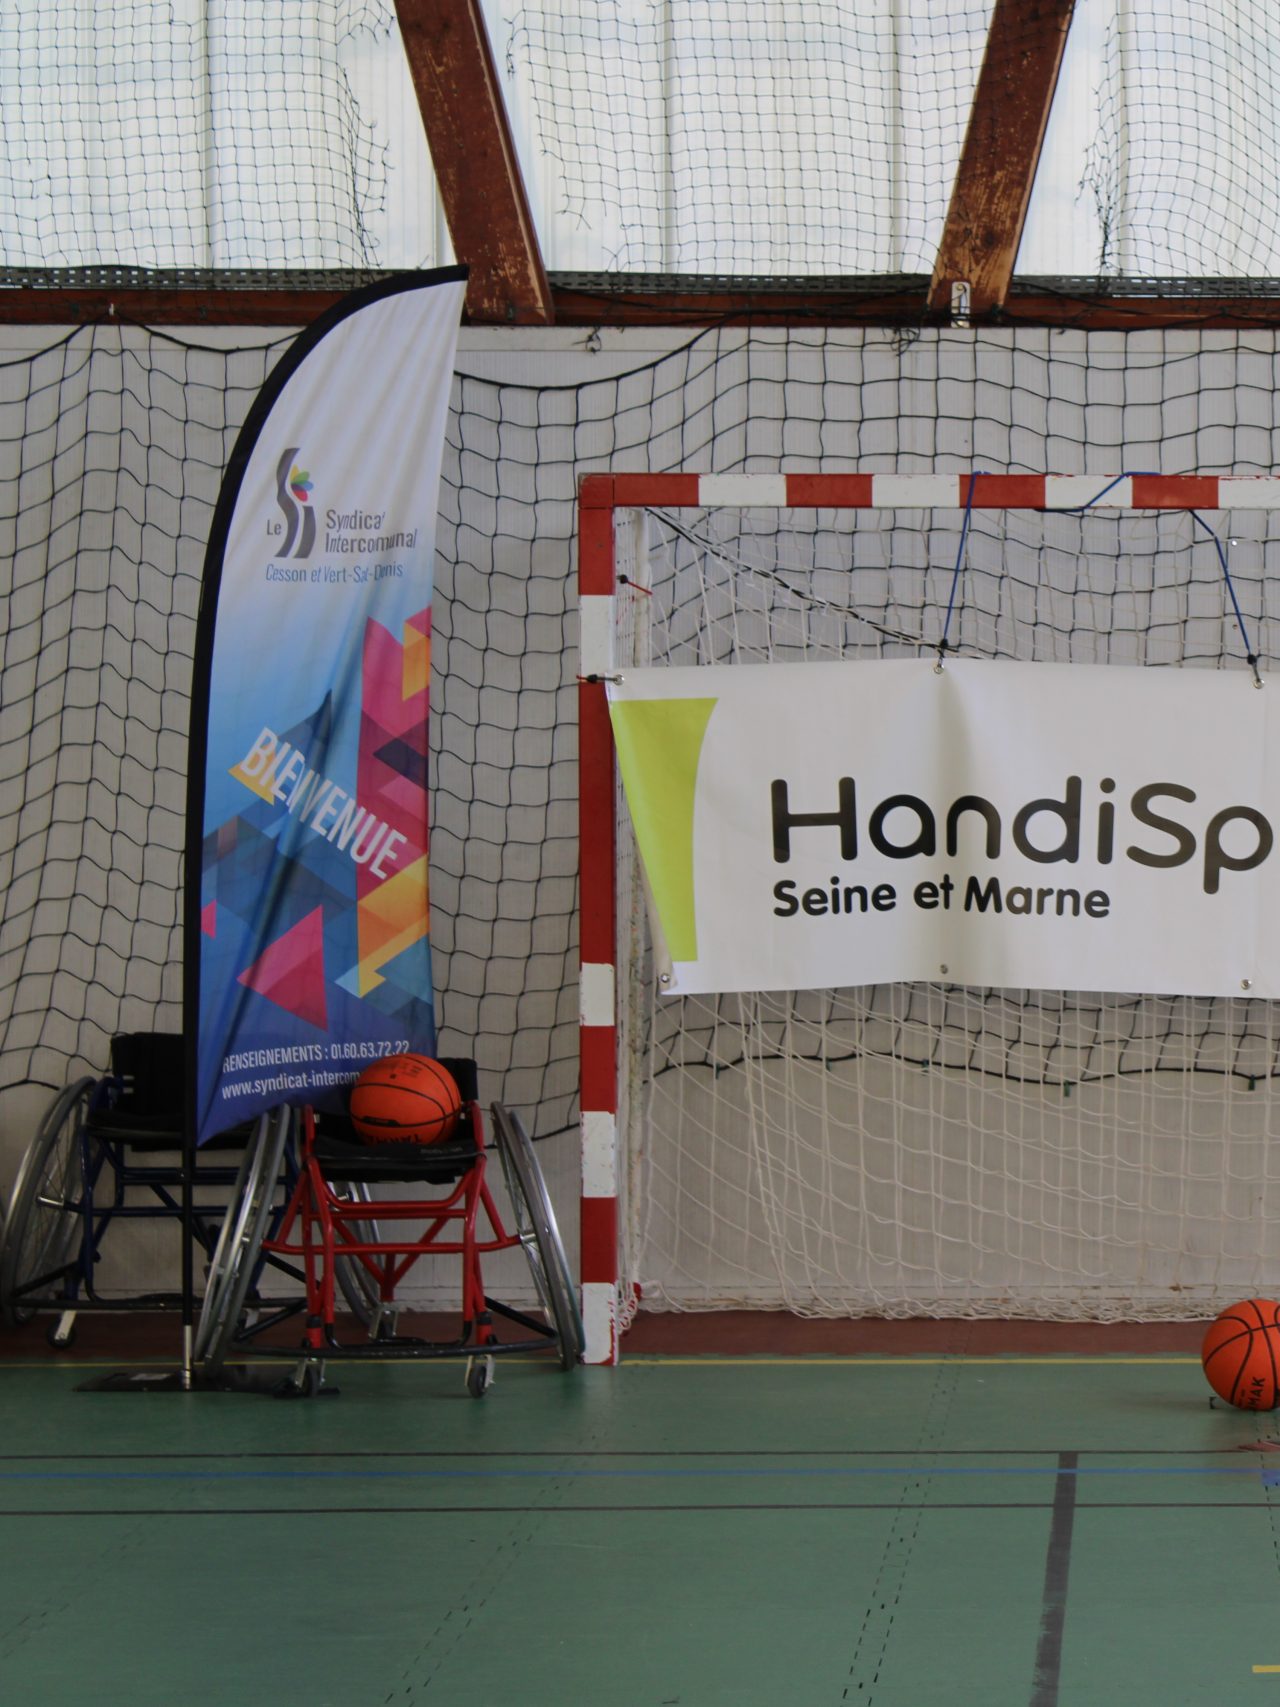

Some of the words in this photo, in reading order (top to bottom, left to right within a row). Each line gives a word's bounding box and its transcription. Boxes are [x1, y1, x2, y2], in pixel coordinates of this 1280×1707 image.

[266, 519, 282, 536] Le
[266, 563, 307, 582] Cesson
[311, 565, 322, 582] et
[240, 727, 408, 880] BIENVENUE
[773, 875, 897, 918] Seine
[913, 873, 954, 911] et
[963, 876, 1111, 919] Marne
[222, 1044, 323, 1074] RENSEIGNEMENTS
